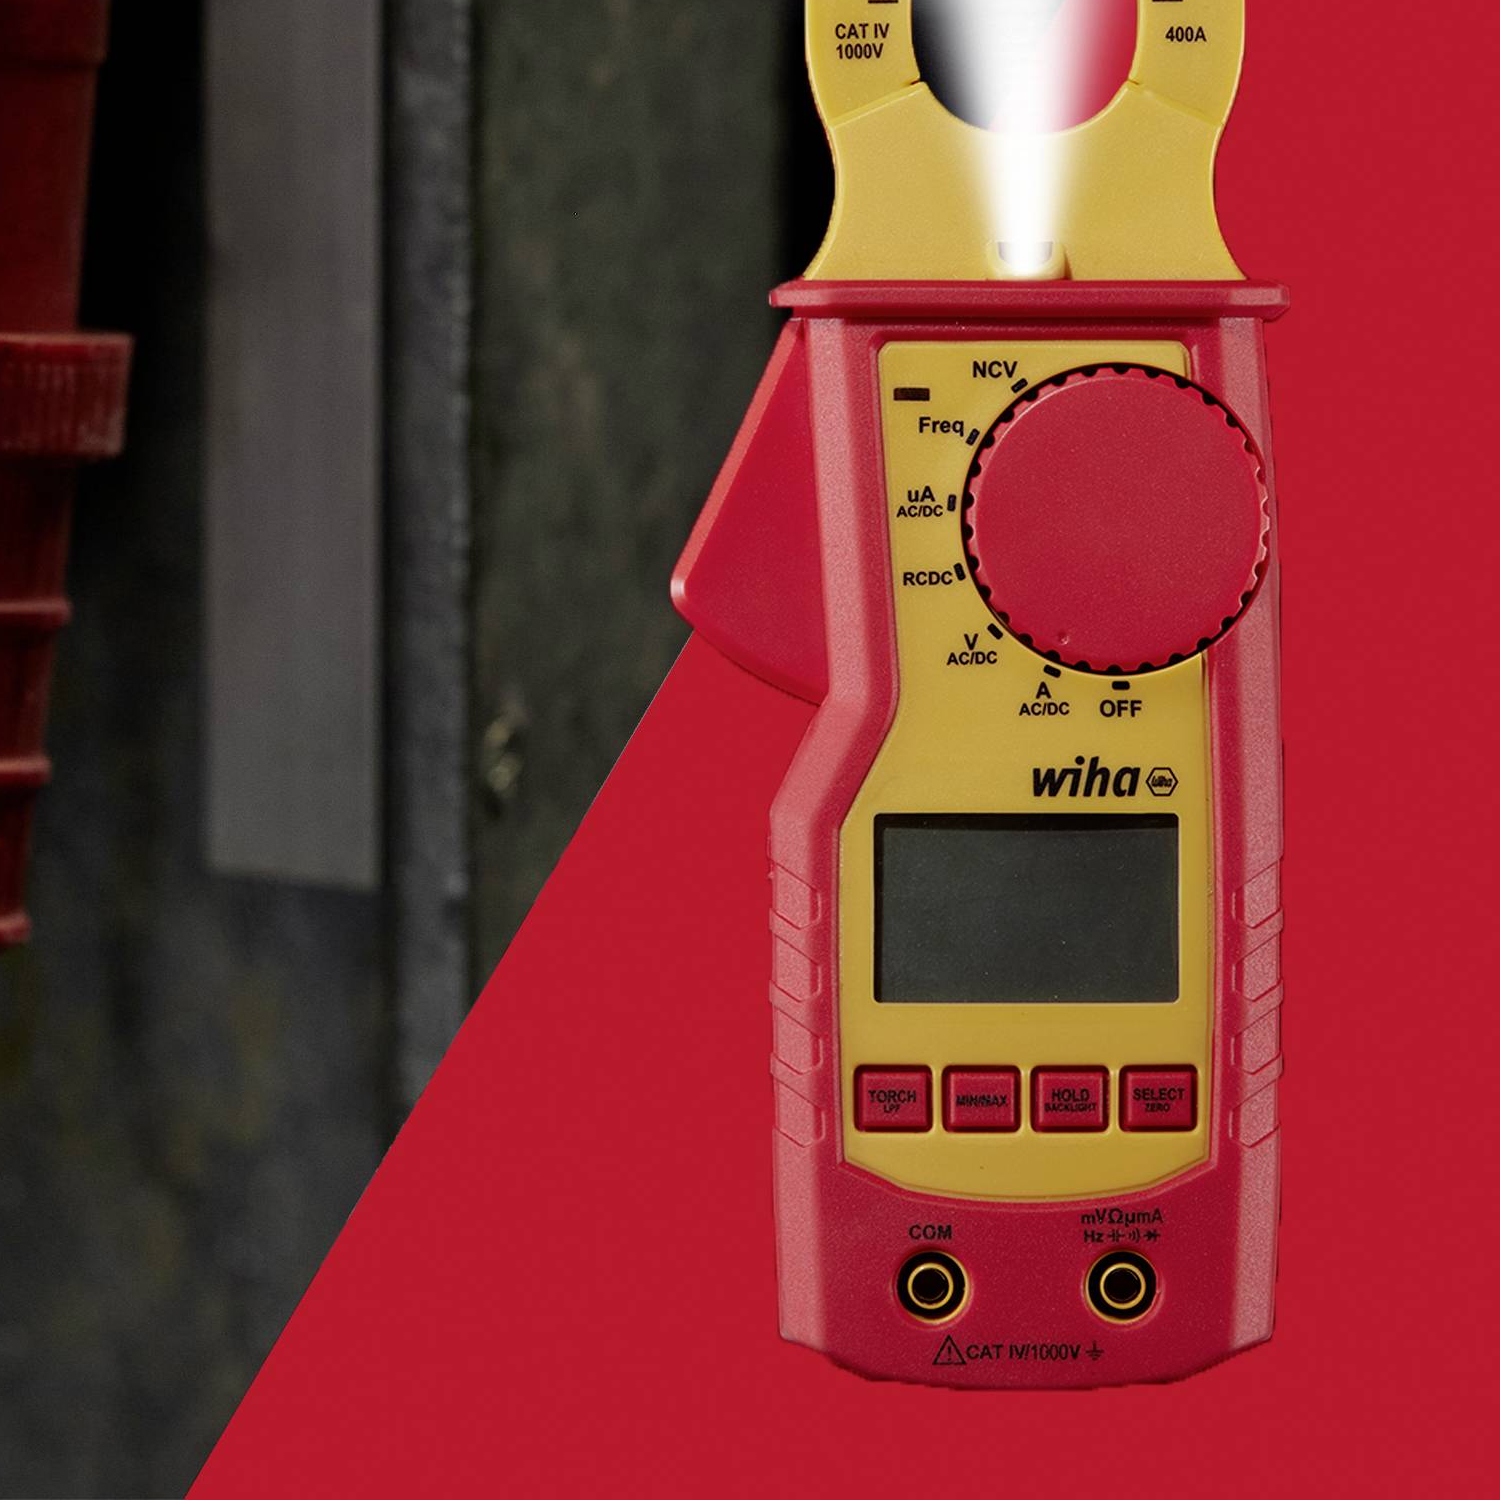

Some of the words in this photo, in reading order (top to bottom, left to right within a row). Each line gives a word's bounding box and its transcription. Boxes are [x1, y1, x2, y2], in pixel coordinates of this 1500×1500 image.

[835, 24, 868, 40] CAT
[874, 23, 890, 39] IV
[1165, 26, 1207, 43] 400A
[836, 43, 884, 59] 1000V
[972, 361, 1017, 379] NCV
[918, 416, 965, 437] Freq
[897, 505, 944, 518] AC/DC
[903, 572, 953, 587] RCDC
[964, 634, 979, 651] V
[946, 652, 998, 666] AC/DC
[1036, 682, 1052, 700] A
[1019, 702, 1070, 717] AC/DC
[1099, 701, 1142, 718] OFF
[1032, 755, 1141, 798] wiha
[868, 1090, 916, 1103] TORCH
[1052, 1088, 1090, 1101] HOLD
[1132, 1088, 1185, 1101] SELECT
[1044, 1103, 1096, 1113] BACKLIGHT
[1145, 1103, 1170, 1113] ZERO
[908, 1225, 952, 1240] COM
[1084, 1230, 1104, 1243] Hz
[966, 1344, 1002, 1360] CAT
